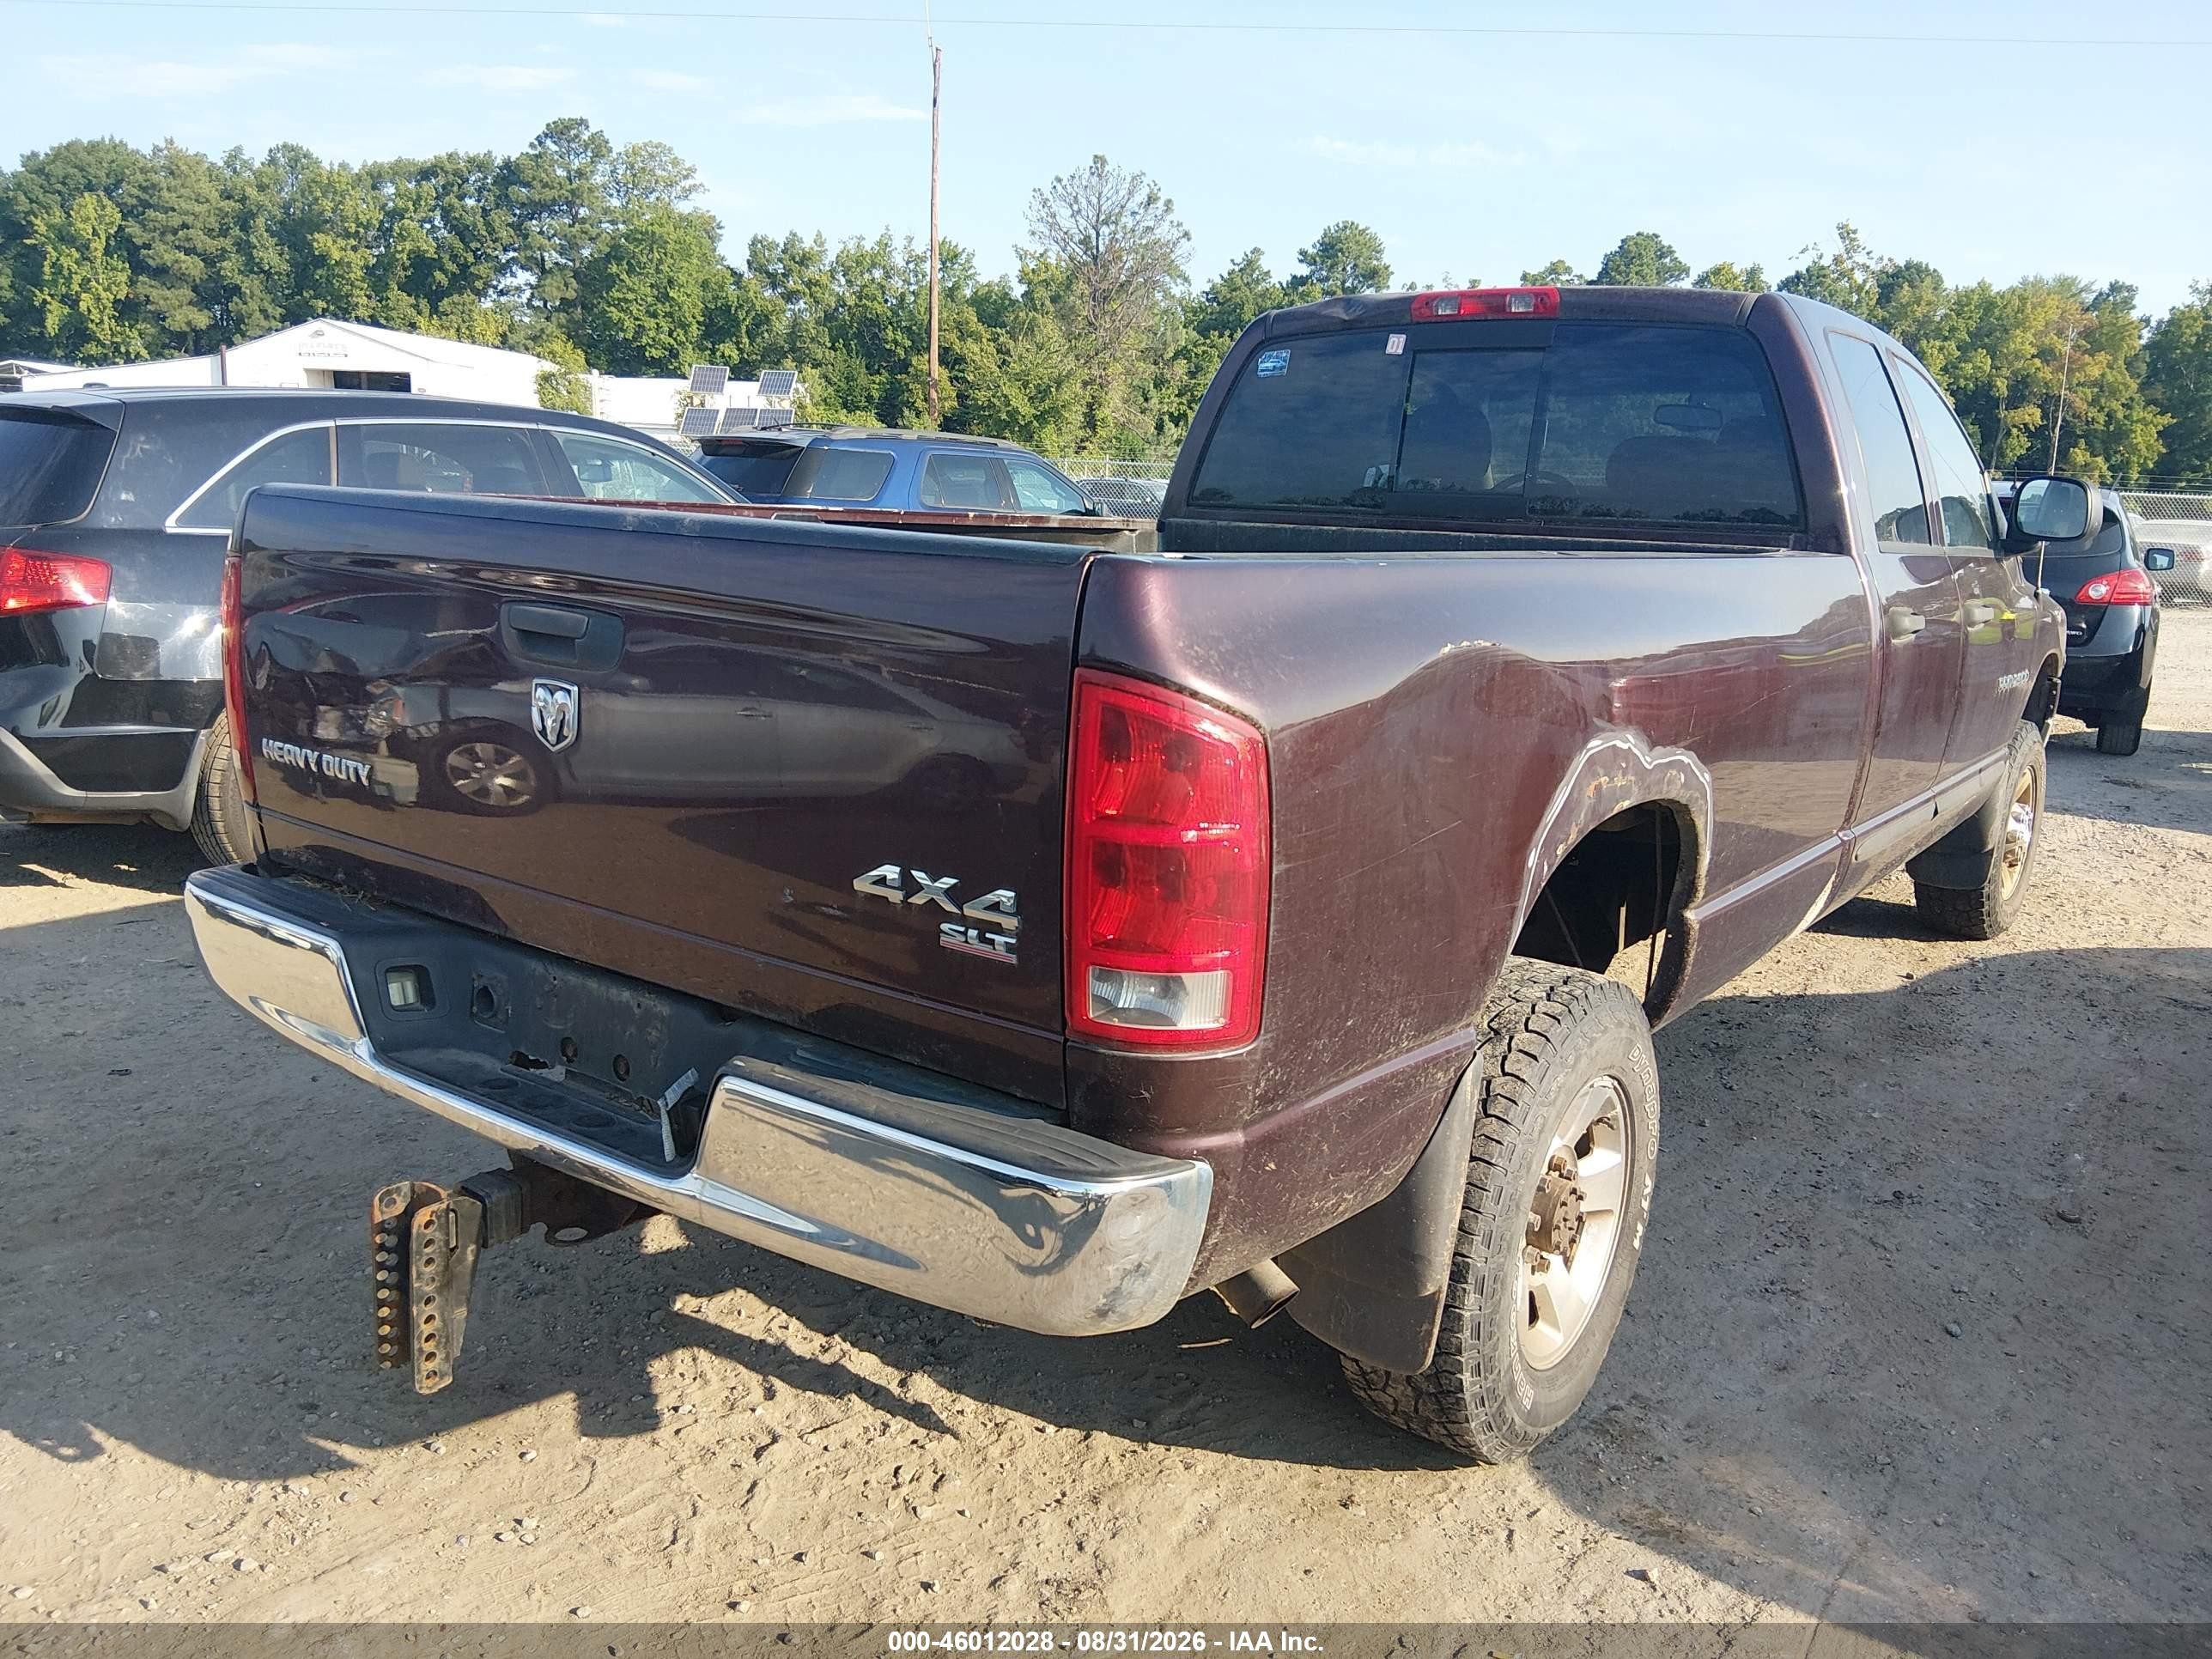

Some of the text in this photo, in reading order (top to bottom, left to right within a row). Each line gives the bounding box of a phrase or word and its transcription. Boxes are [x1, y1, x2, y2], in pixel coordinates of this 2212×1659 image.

[261, 738, 371, 787] HEAVY DUTY
[852, 863, 1020, 932] 4X4
[939, 922, 1018, 955] SLT
